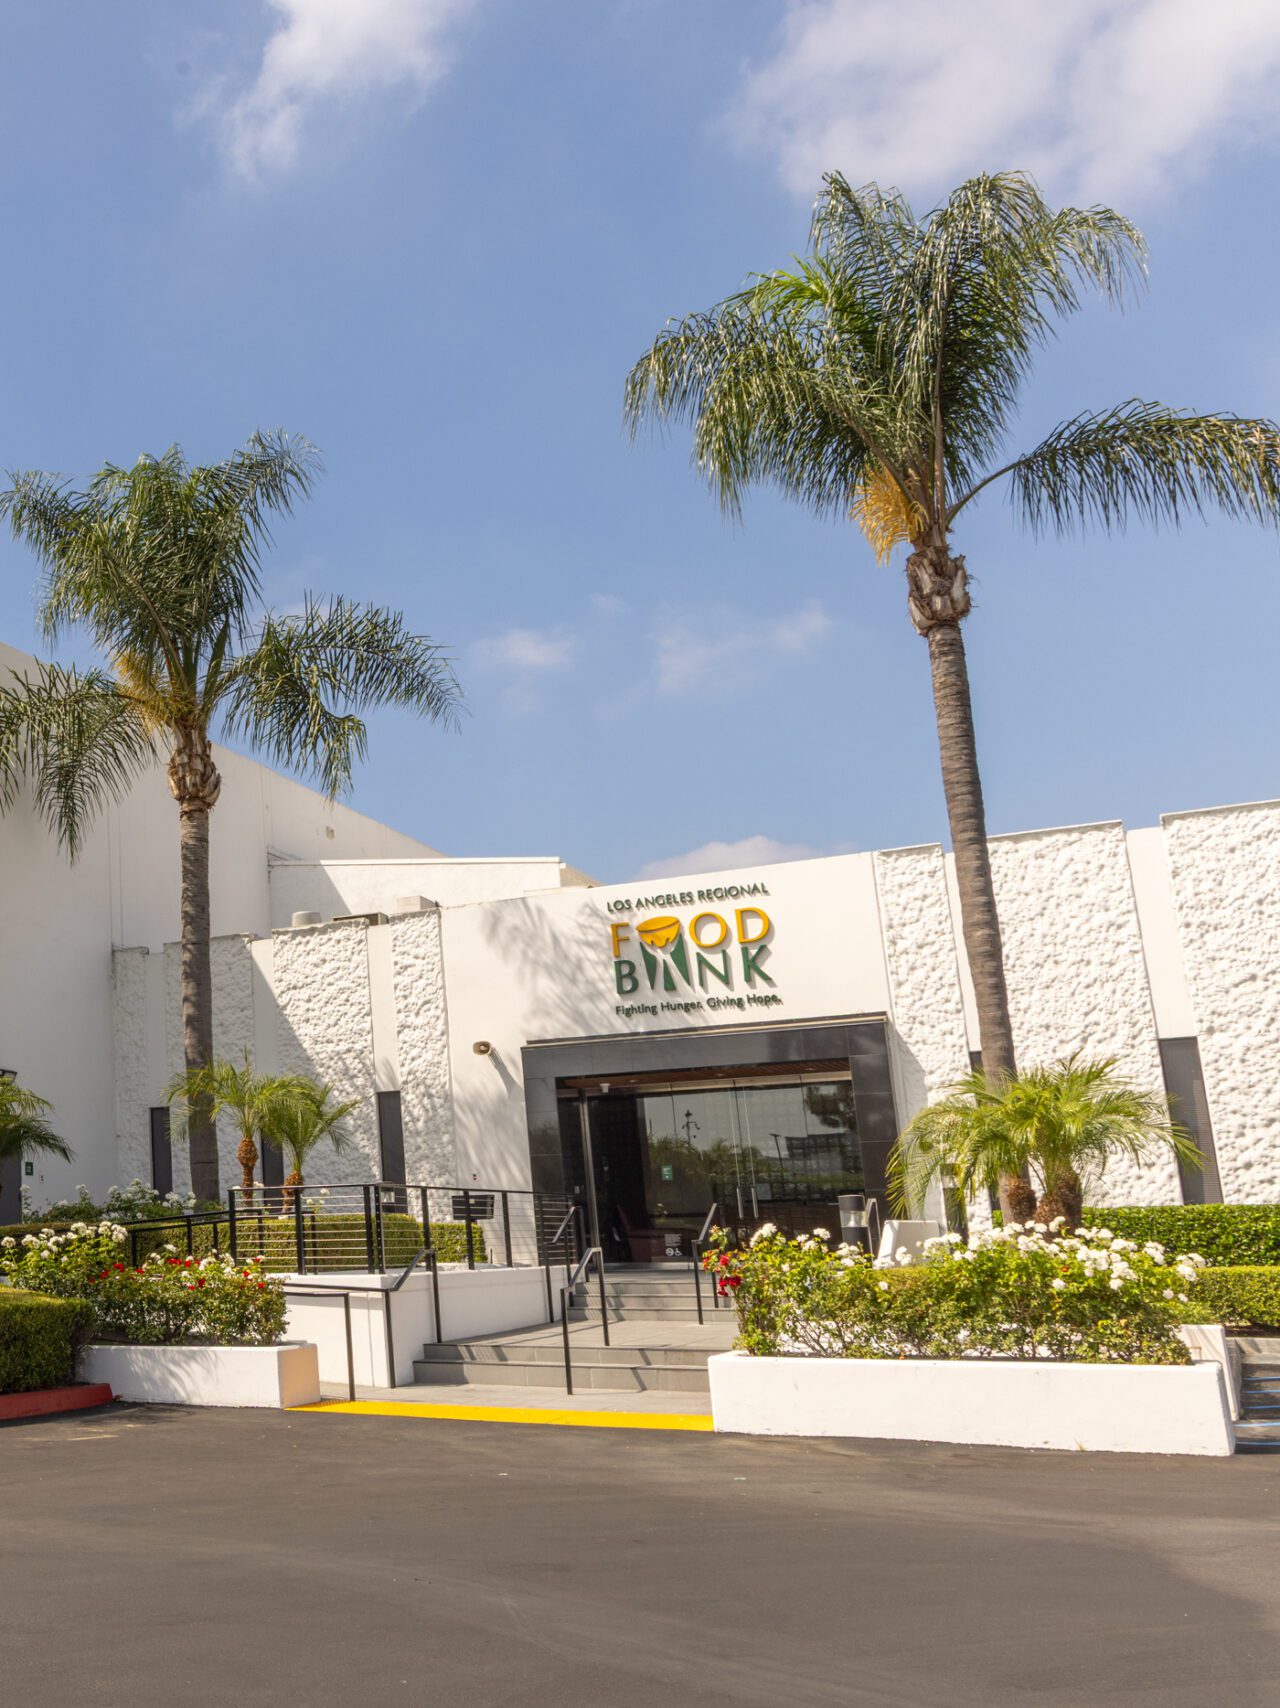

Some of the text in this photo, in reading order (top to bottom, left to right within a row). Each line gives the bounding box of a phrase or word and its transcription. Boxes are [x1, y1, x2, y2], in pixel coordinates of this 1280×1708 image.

[607, 882, 769, 913] LOS ANGELES REGIONAL
[615, 993, 782, 1018] Fighting Hunger. Giving Hope.
